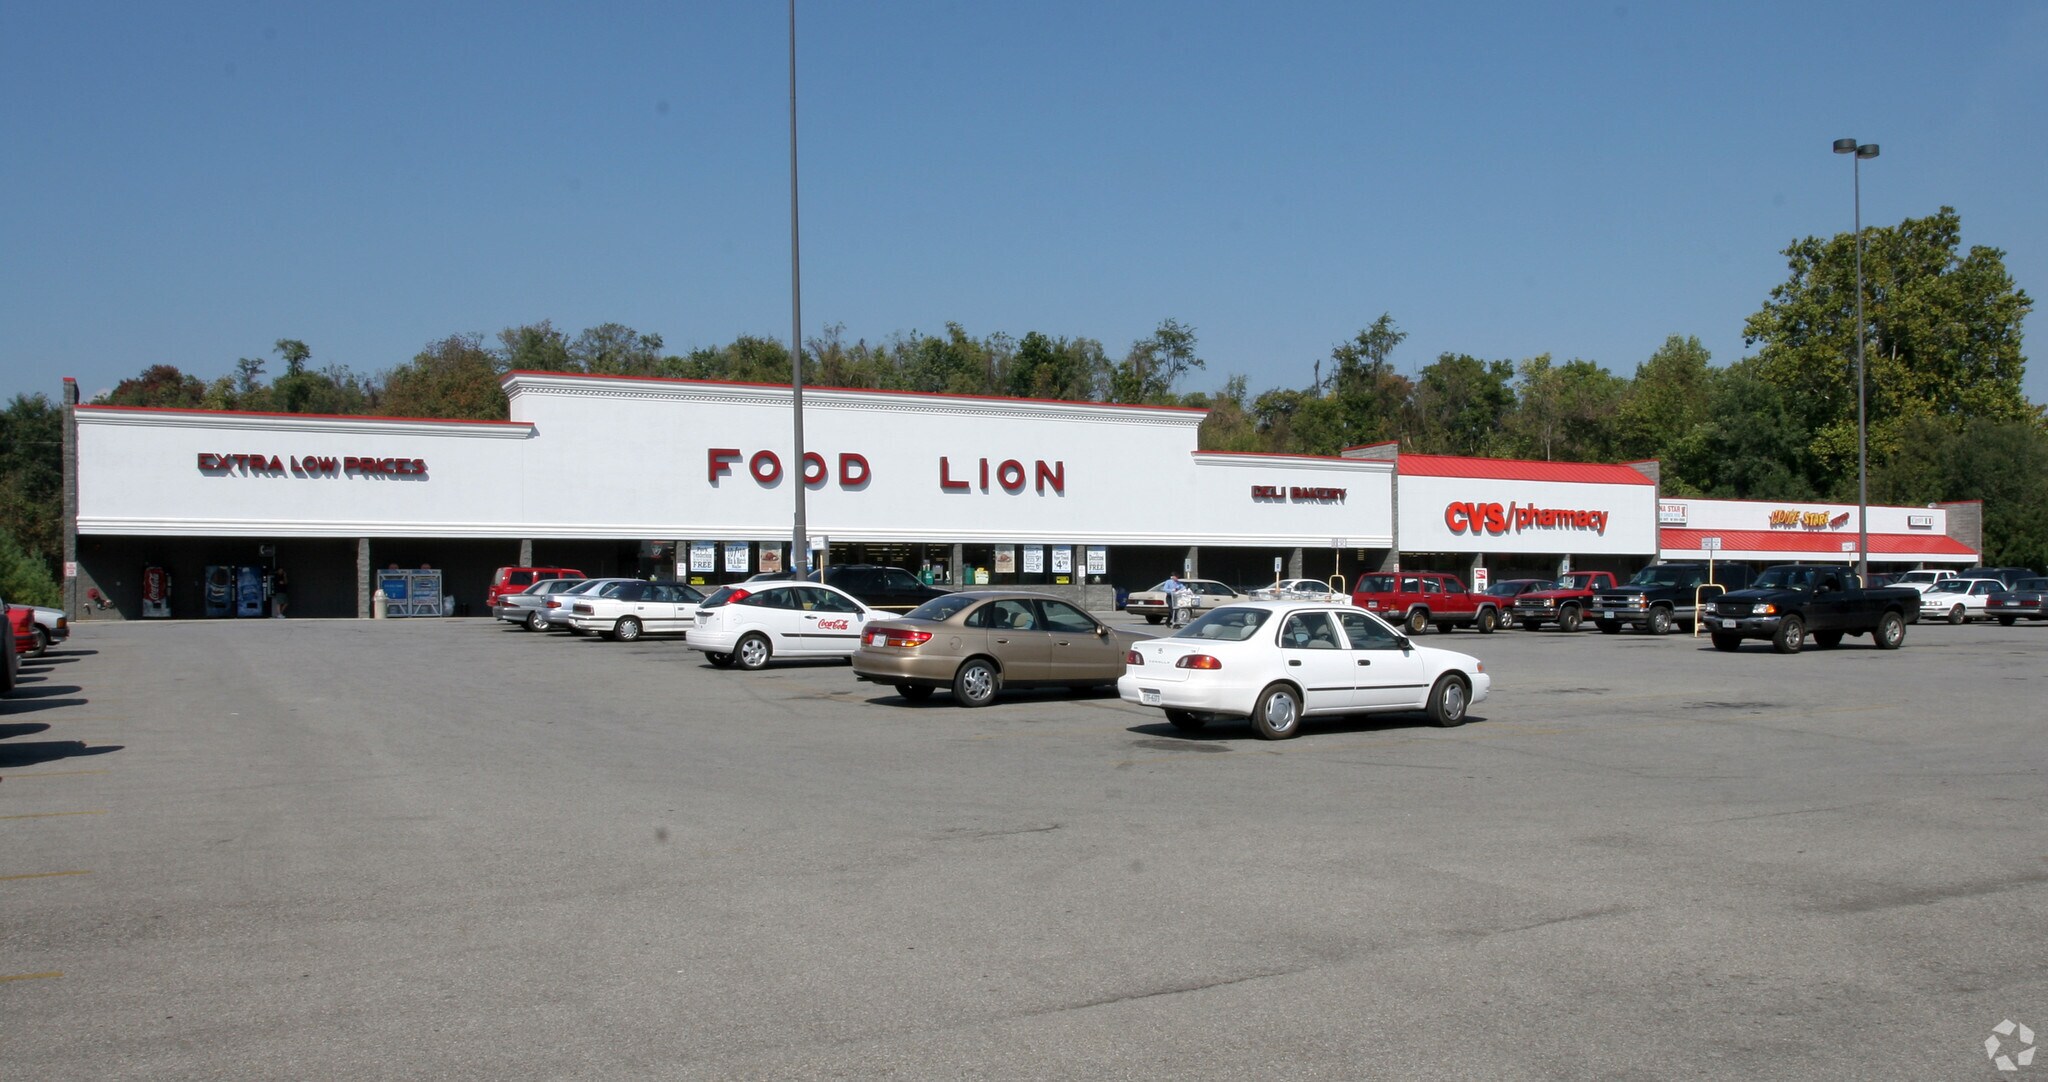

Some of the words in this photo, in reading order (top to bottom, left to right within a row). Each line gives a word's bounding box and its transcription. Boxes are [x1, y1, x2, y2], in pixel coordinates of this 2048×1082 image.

[197, 453, 283, 471] EXTRA
[290, 455, 337, 472] LOW
[344, 456, 425, 474] PRICES
[707, 448, 870, 485] FOOD
[939, 456, 1064, 492] LION
[1251, 485, 1286, 499] DELI
[1289, 486, 1347, 500] BAKERY
